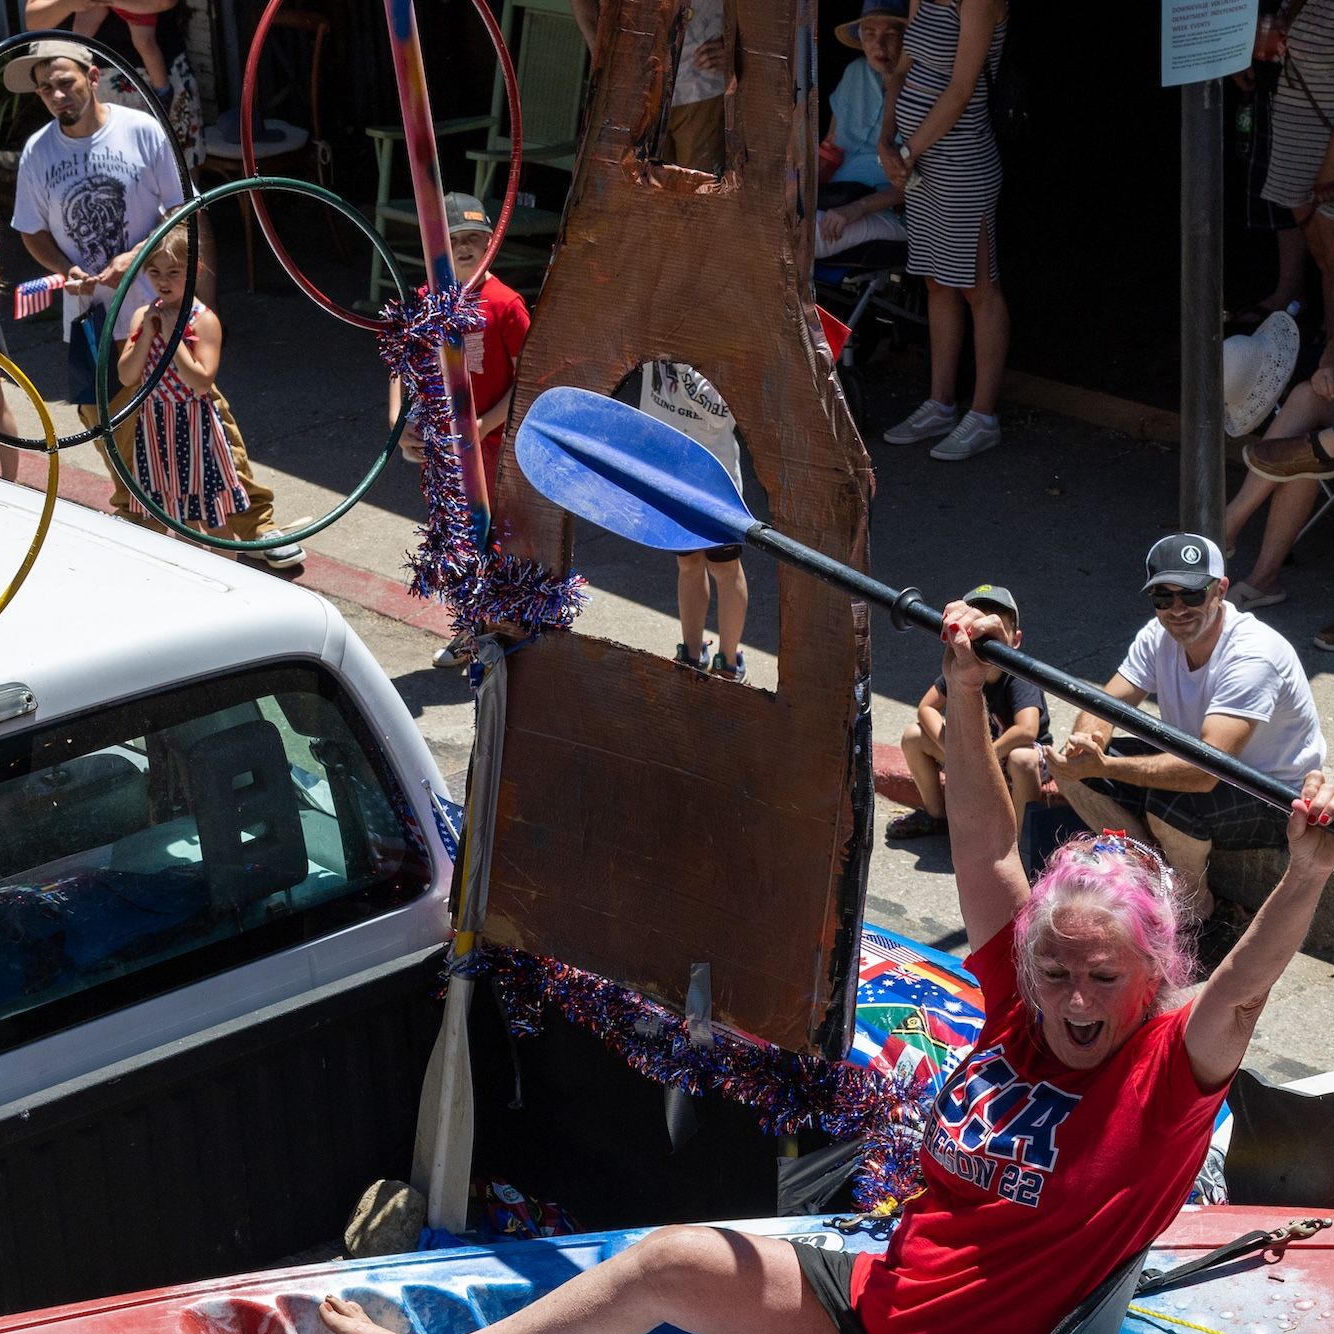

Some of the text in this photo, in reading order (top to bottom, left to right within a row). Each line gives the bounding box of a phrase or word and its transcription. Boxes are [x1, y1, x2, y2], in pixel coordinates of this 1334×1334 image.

[1172, 12, 1208, 23] DEPARTMENT
[923, 1117, 1045, 1208] REGON 22
